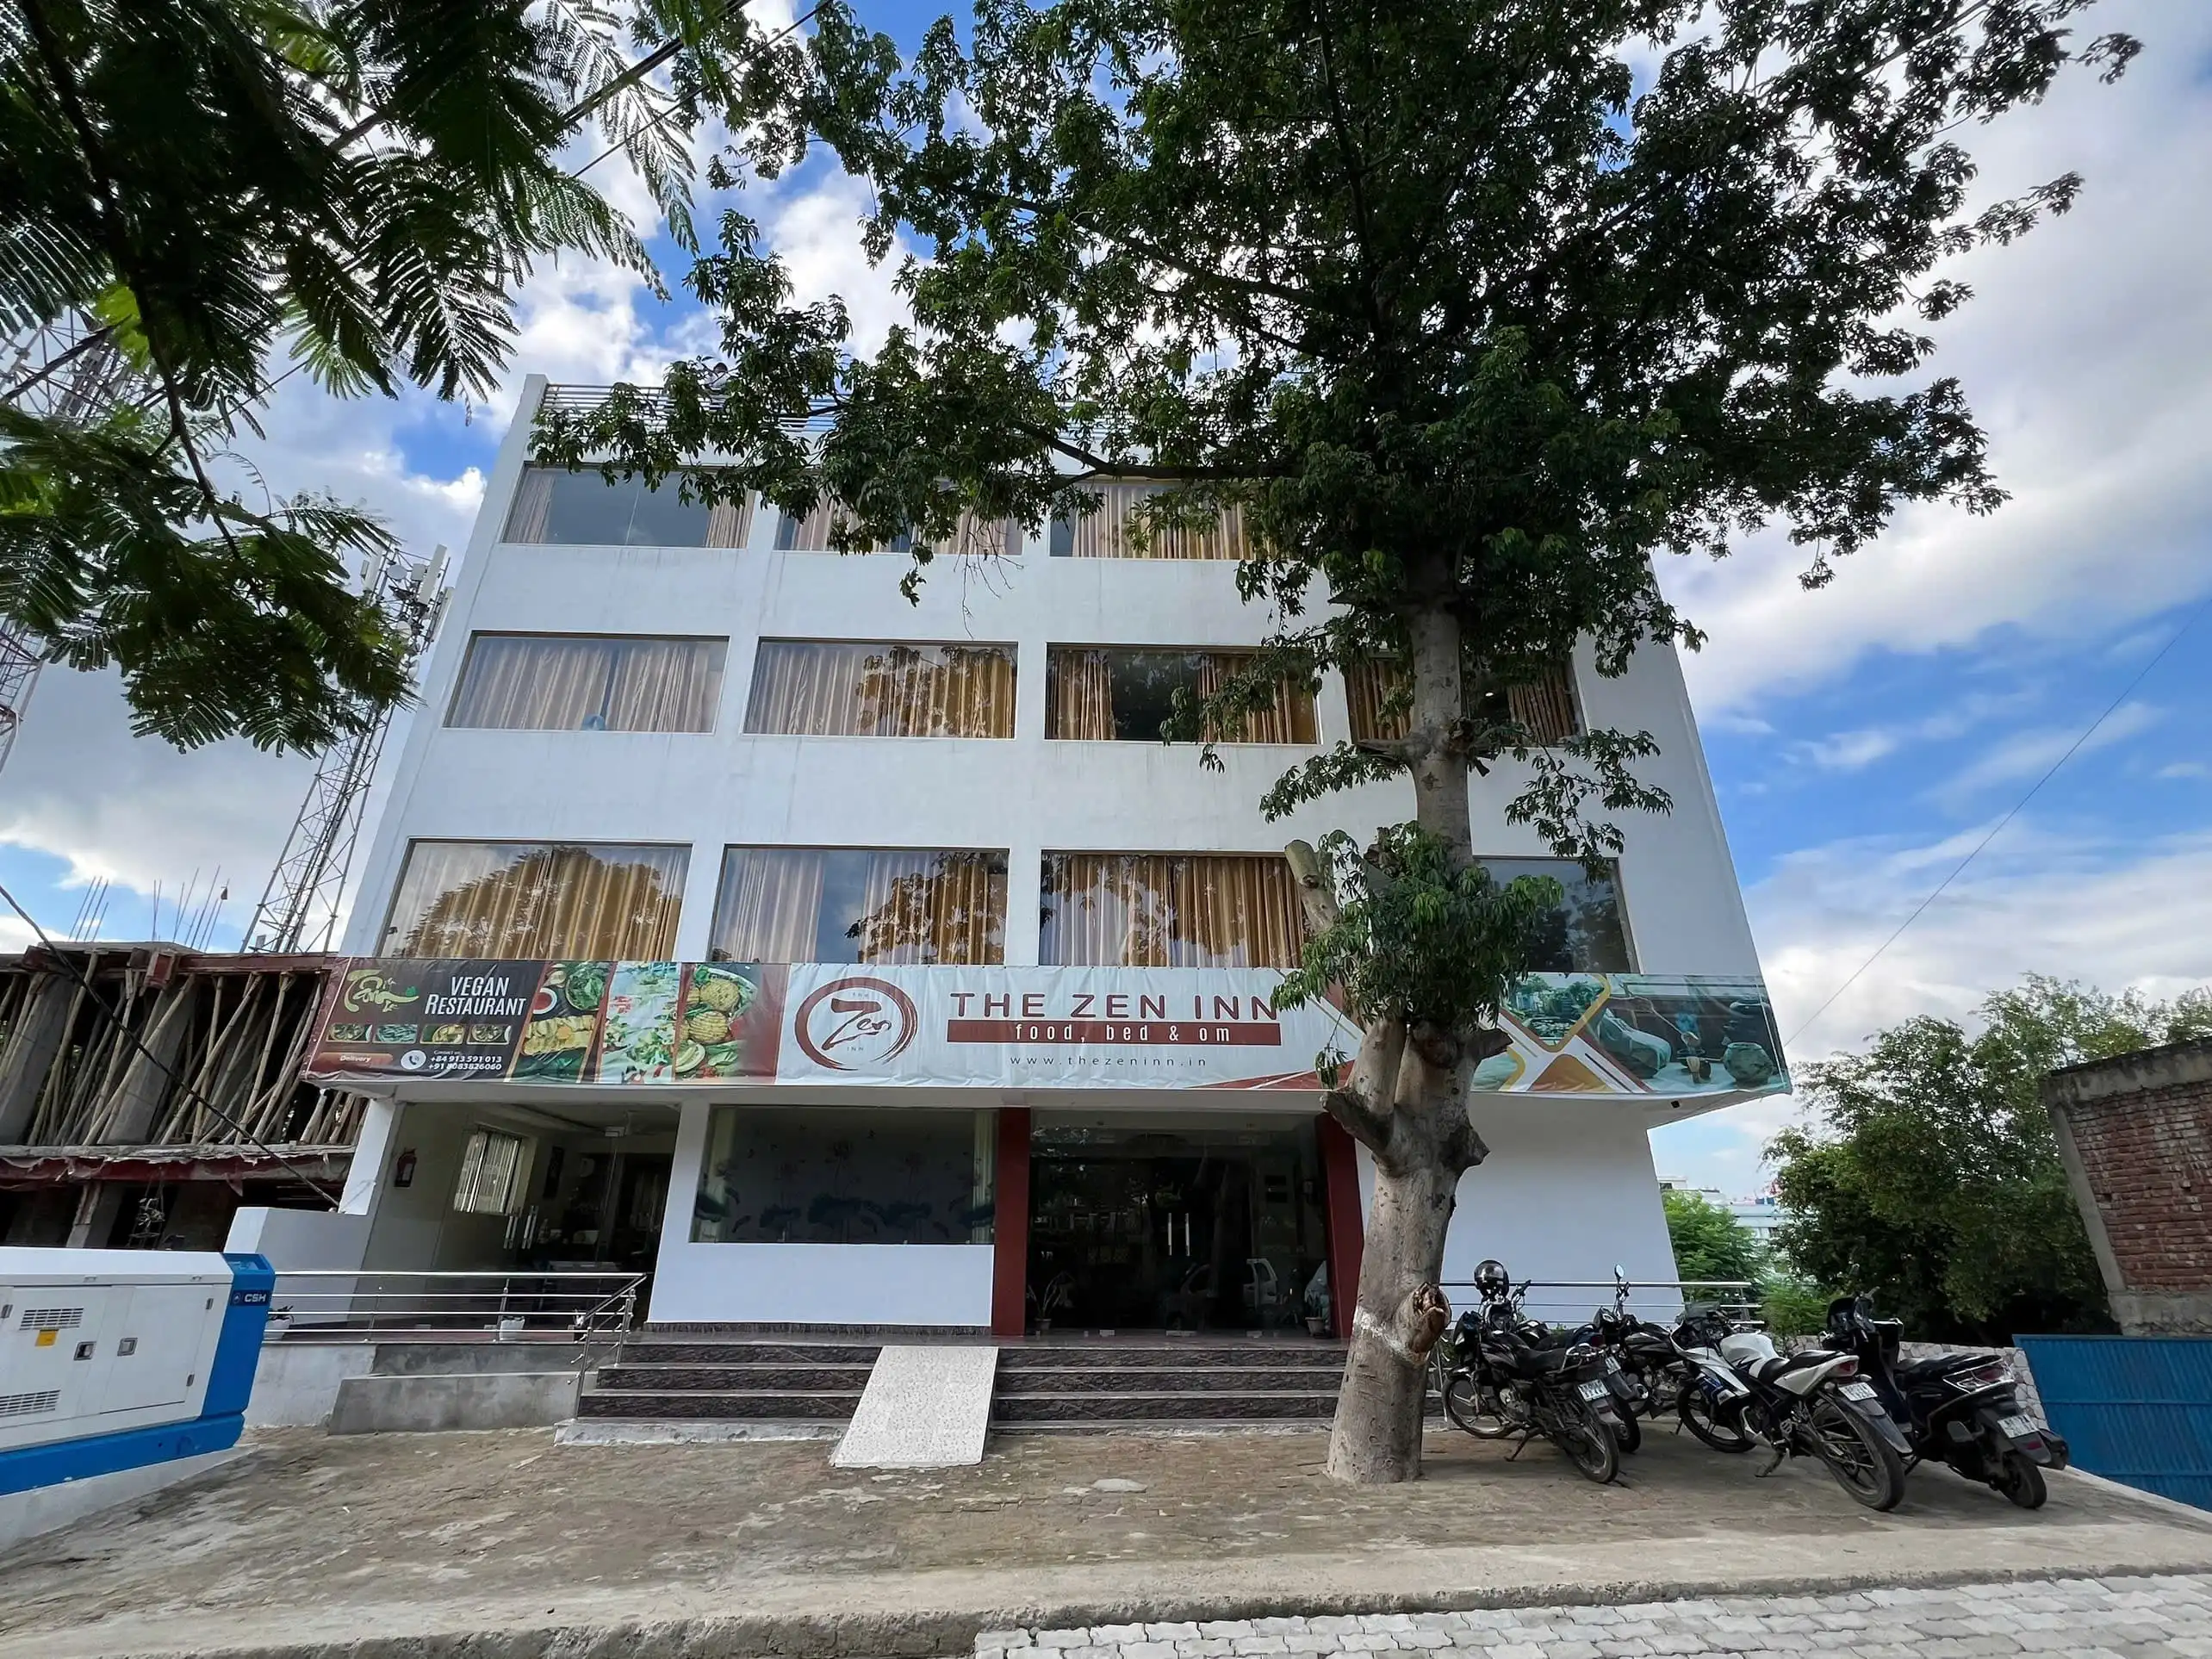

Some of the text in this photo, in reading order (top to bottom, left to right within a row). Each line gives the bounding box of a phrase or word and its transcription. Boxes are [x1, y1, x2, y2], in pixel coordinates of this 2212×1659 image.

[450, 976, 510, 997] VEGAN
[950, 992, 1278, 1021] THE ZEN INN
[821, 997, 892, 1051] Zen
[1015, 1023, 1230, 1043] food, bed & om
[1010, 1055, 1206, 1066] www.thezeninn.in
